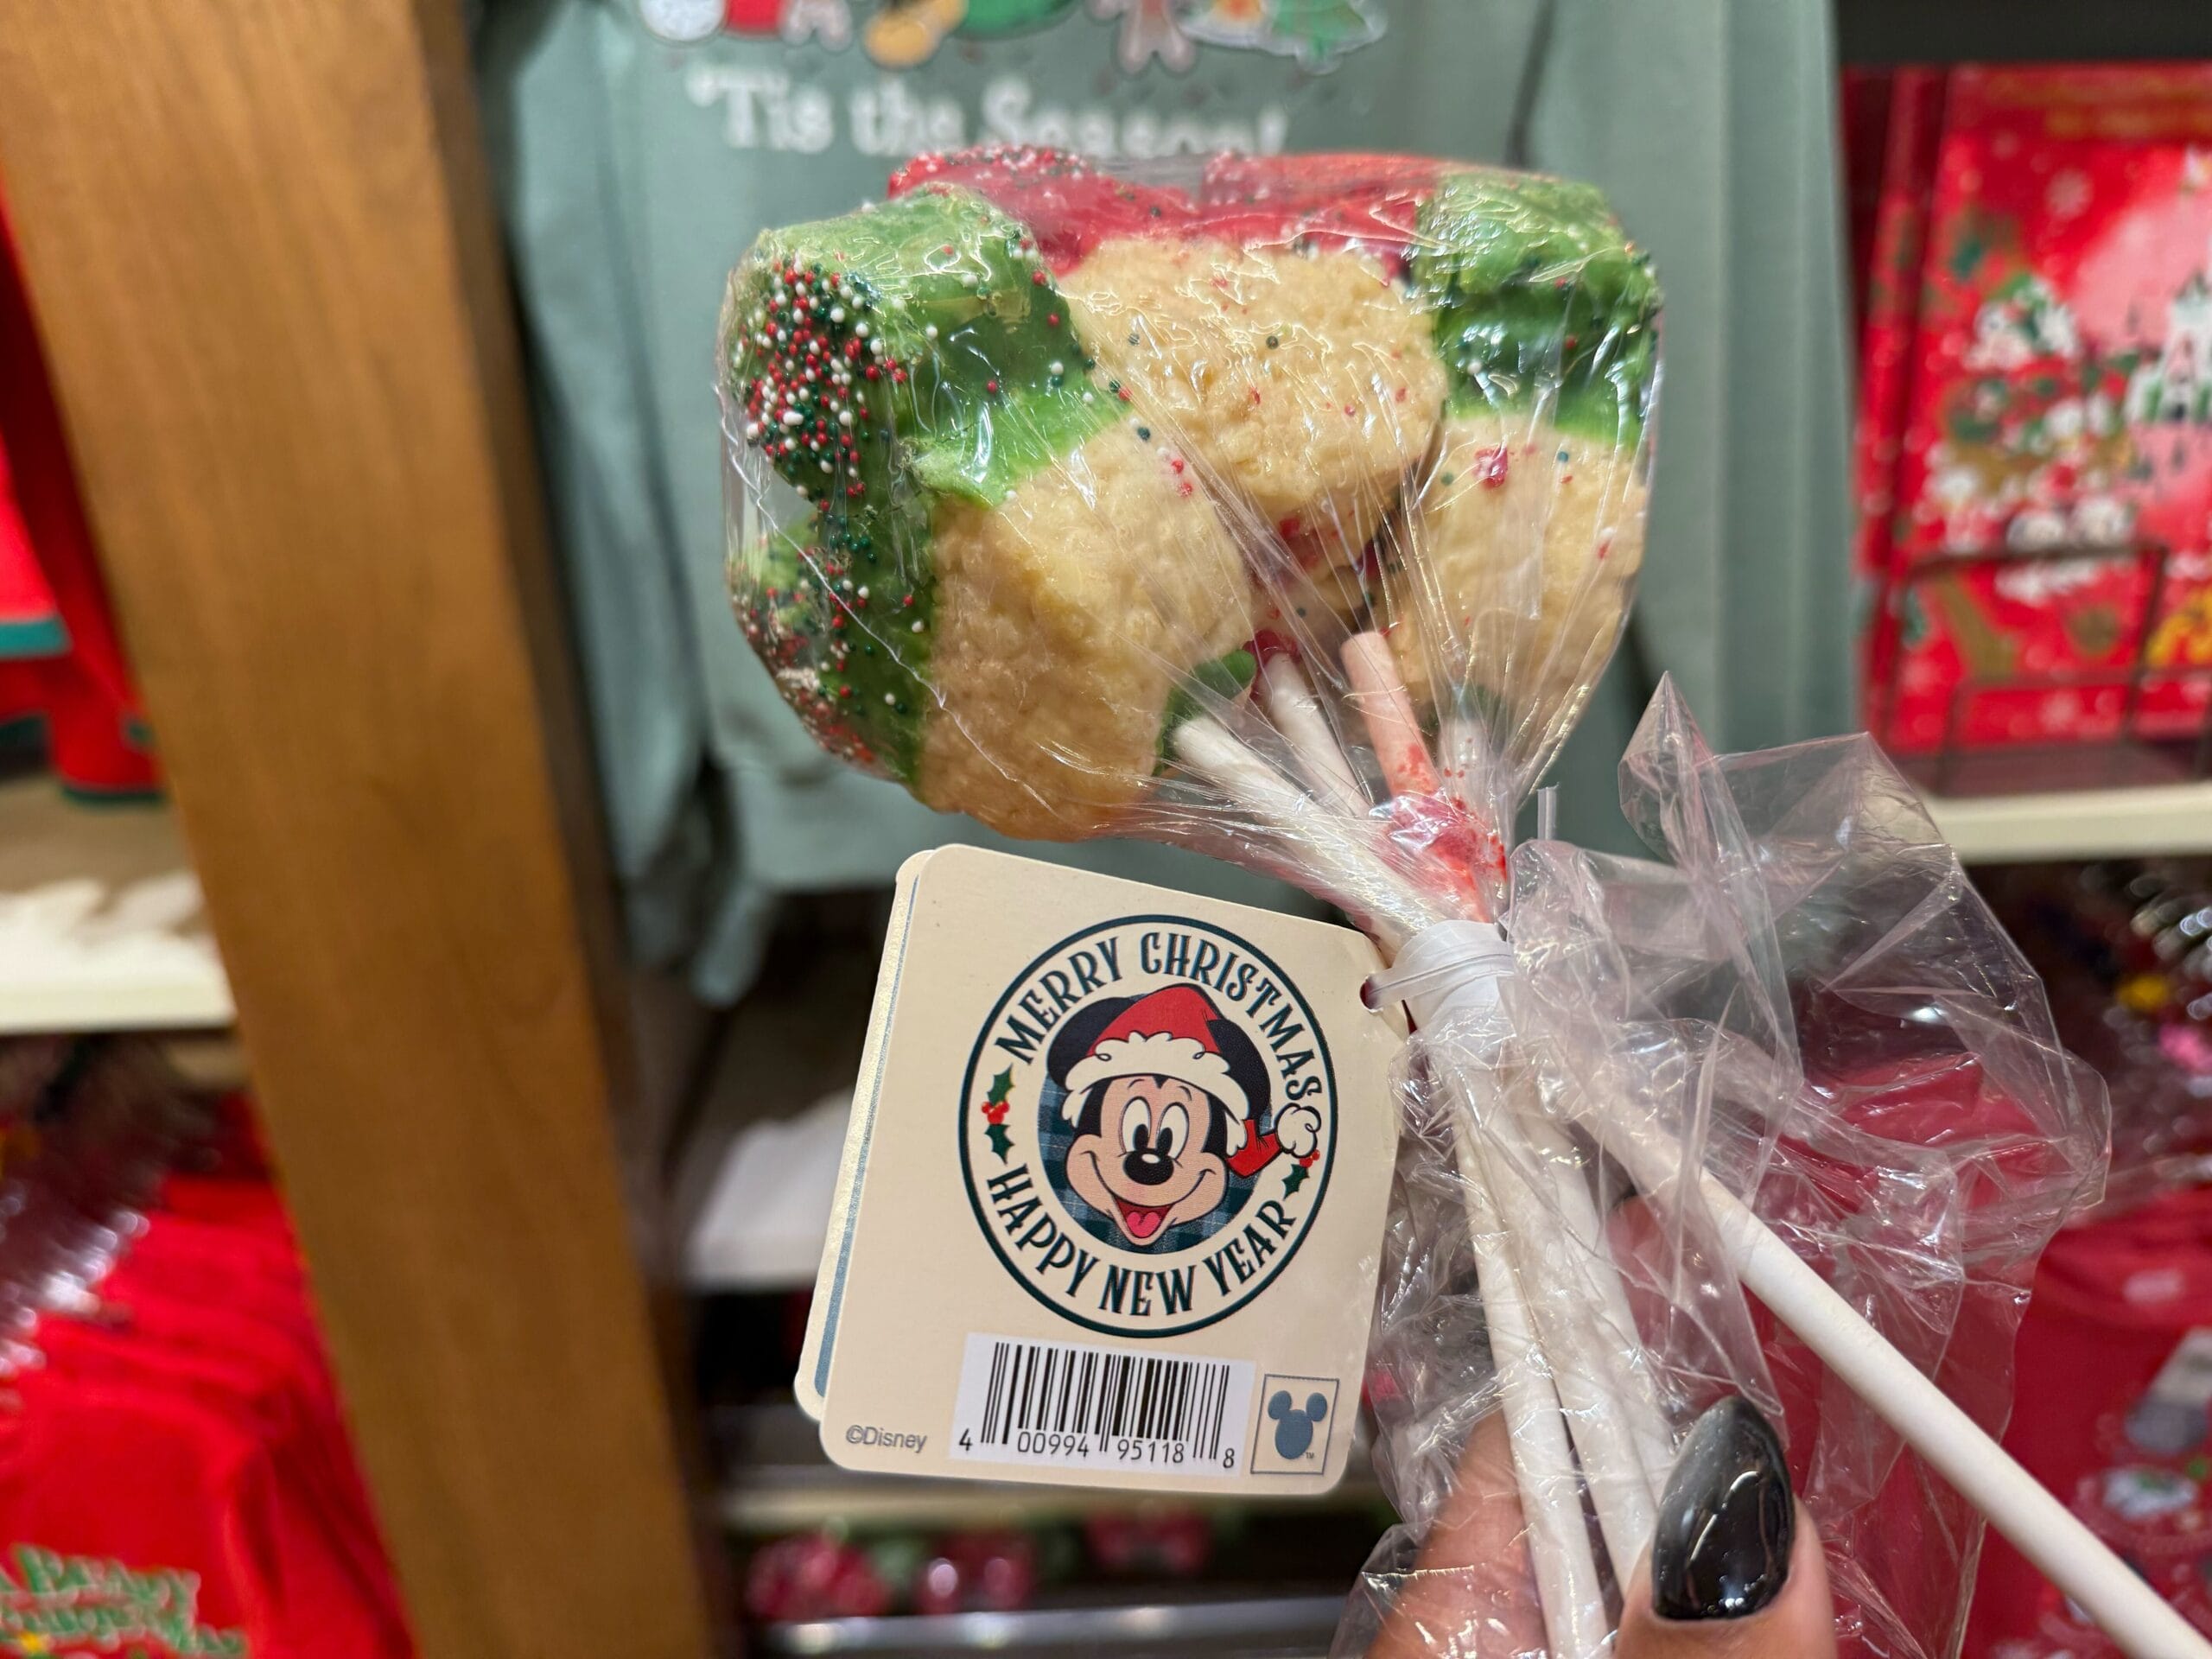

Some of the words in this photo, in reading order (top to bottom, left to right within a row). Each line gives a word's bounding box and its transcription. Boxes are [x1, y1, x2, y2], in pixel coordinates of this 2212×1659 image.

[847, 78, 963, 156] the
[995, 937, 1123, 1065] MERRY
[1140, 931, 1323, 1101] CHRISTMAS
[986, 1163, 1100, 1298] HAPPY
[1098, 1263, 1198, 1316] NEW
[1202, 1199, 1296, 1298] YEAR
[846, 1424, 927, 1453] ©Disney
[958, 1427, 973, 1452] 4
[1017, 1431, 1089, 1458] 00994
[1117, 1439, 1185, 1464] 95118
[1223, 1447, 1236, 1469] 8
